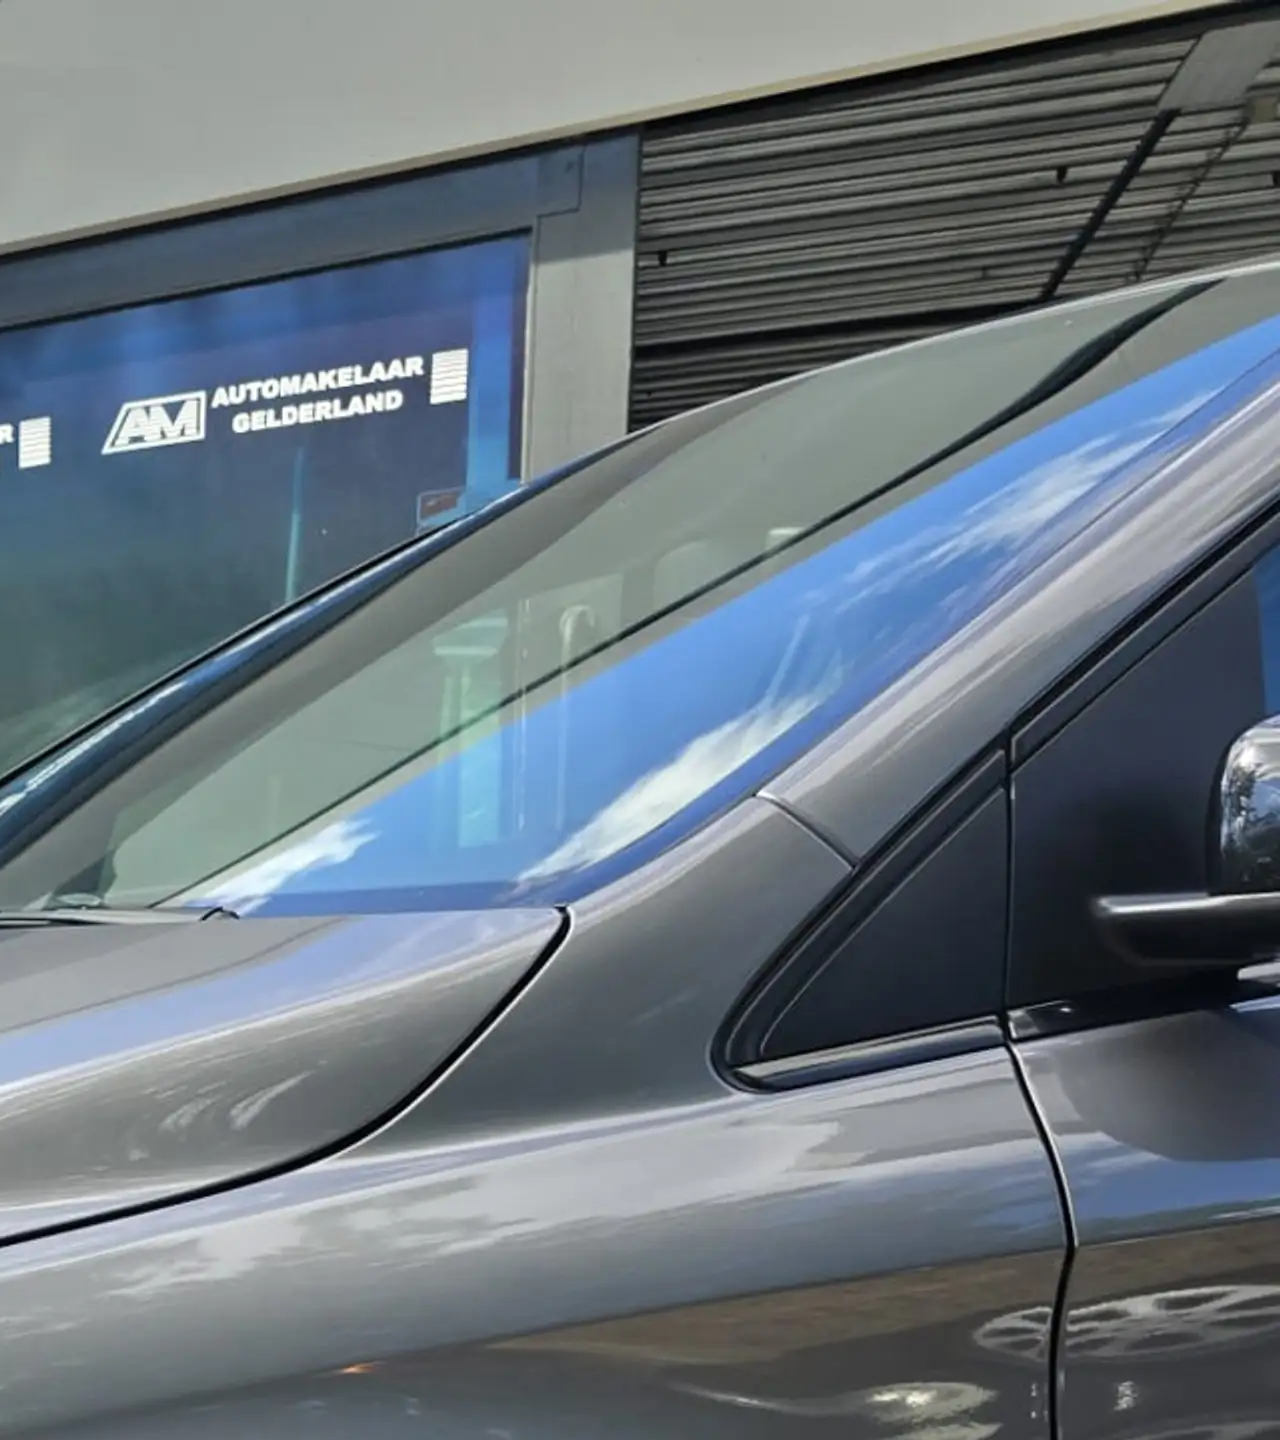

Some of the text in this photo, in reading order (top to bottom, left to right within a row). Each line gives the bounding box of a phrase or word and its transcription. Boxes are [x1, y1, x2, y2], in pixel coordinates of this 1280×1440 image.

[211, 356, 425, 408] AUTOMAKELAAR
[113, 399, 198, 447] AM
[232, 390, 403, 433] GELDERLAND
